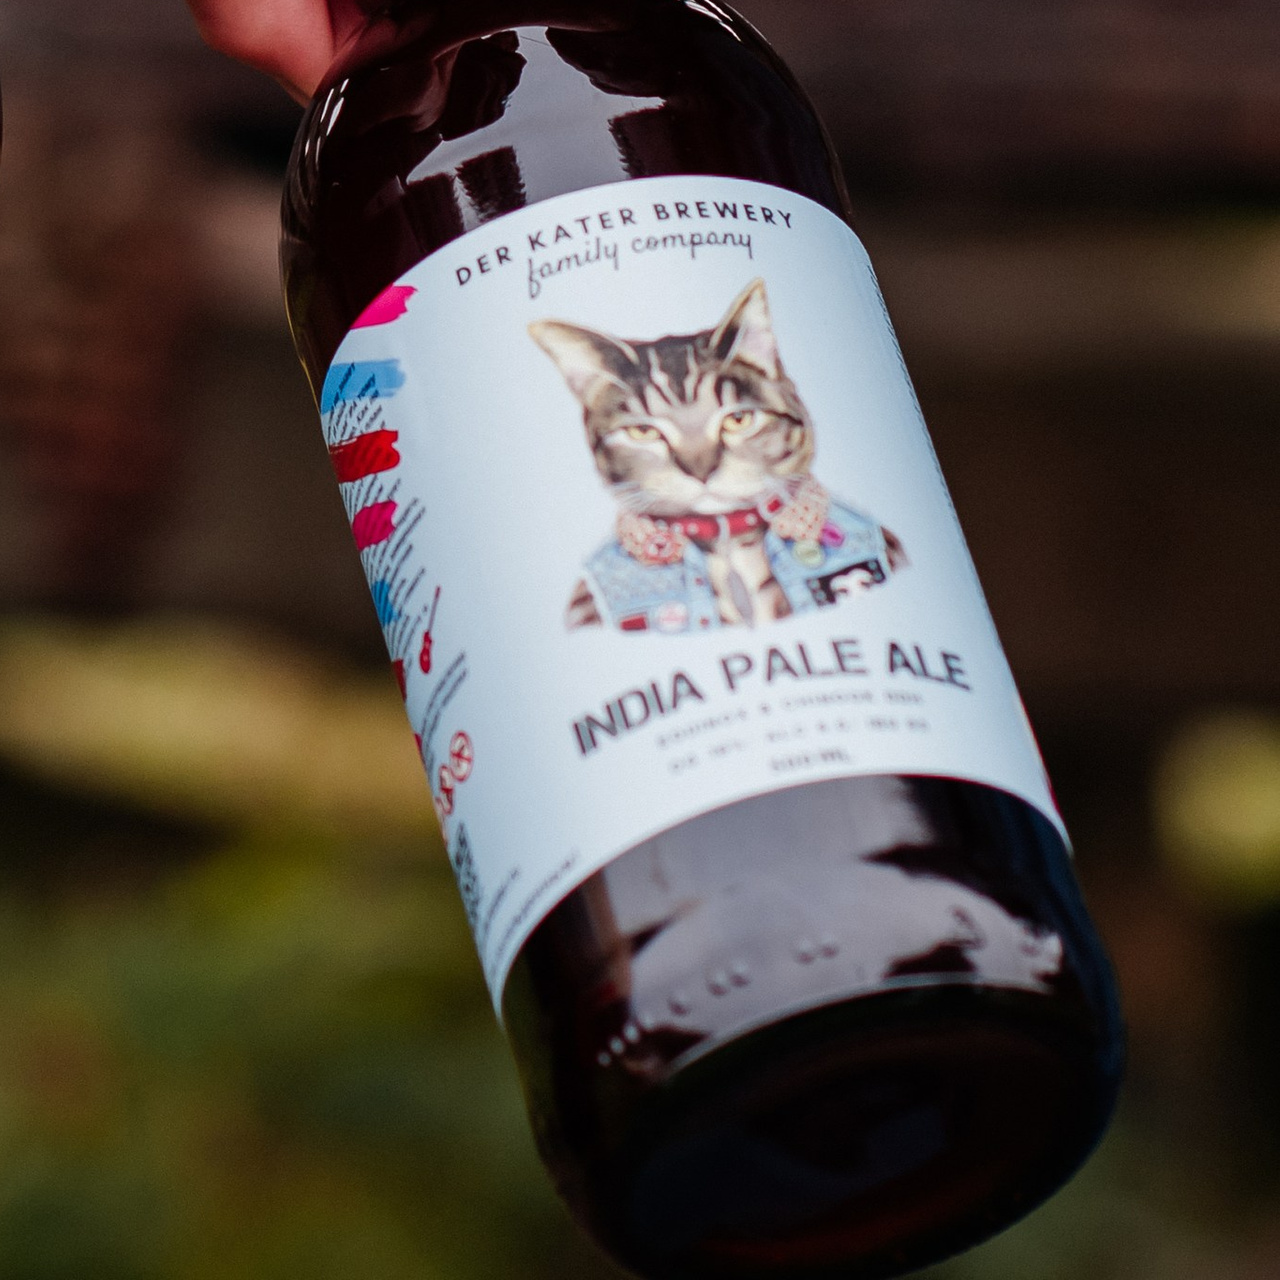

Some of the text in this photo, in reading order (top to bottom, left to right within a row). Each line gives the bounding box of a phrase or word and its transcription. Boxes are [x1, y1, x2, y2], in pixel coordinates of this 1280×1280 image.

[455, 201, 793, 287] DER KATER BREWERY
[526, 230, 755, 300] family company
[572, 671, 705, 757] INDIA
[721, 638, 869, 692] PALE
[888, 641, 971, 692] ALE
